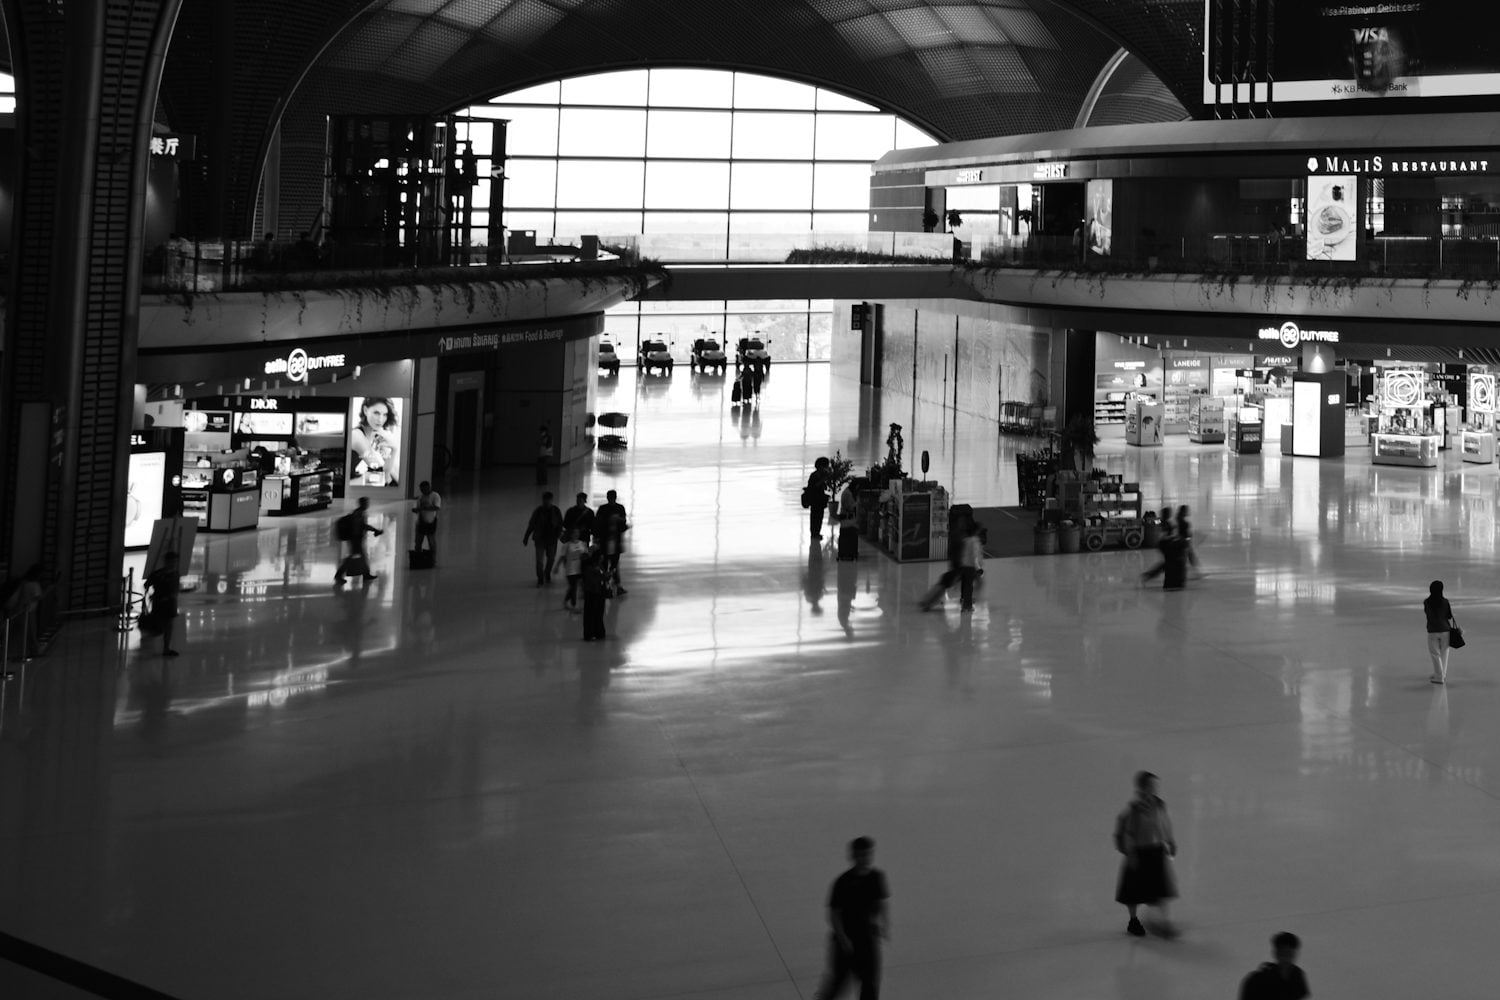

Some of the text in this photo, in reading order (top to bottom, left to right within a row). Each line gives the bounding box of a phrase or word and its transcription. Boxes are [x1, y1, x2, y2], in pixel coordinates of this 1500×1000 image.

[1351, 27, 1388, 44] VISA
[1344, 84, 1356, 93] KB
[1388, 83, 1408, 92] Bank
[1392, 161, 1488, 172] RESTAURANT
[250, 398, 278, 410] DIOR
